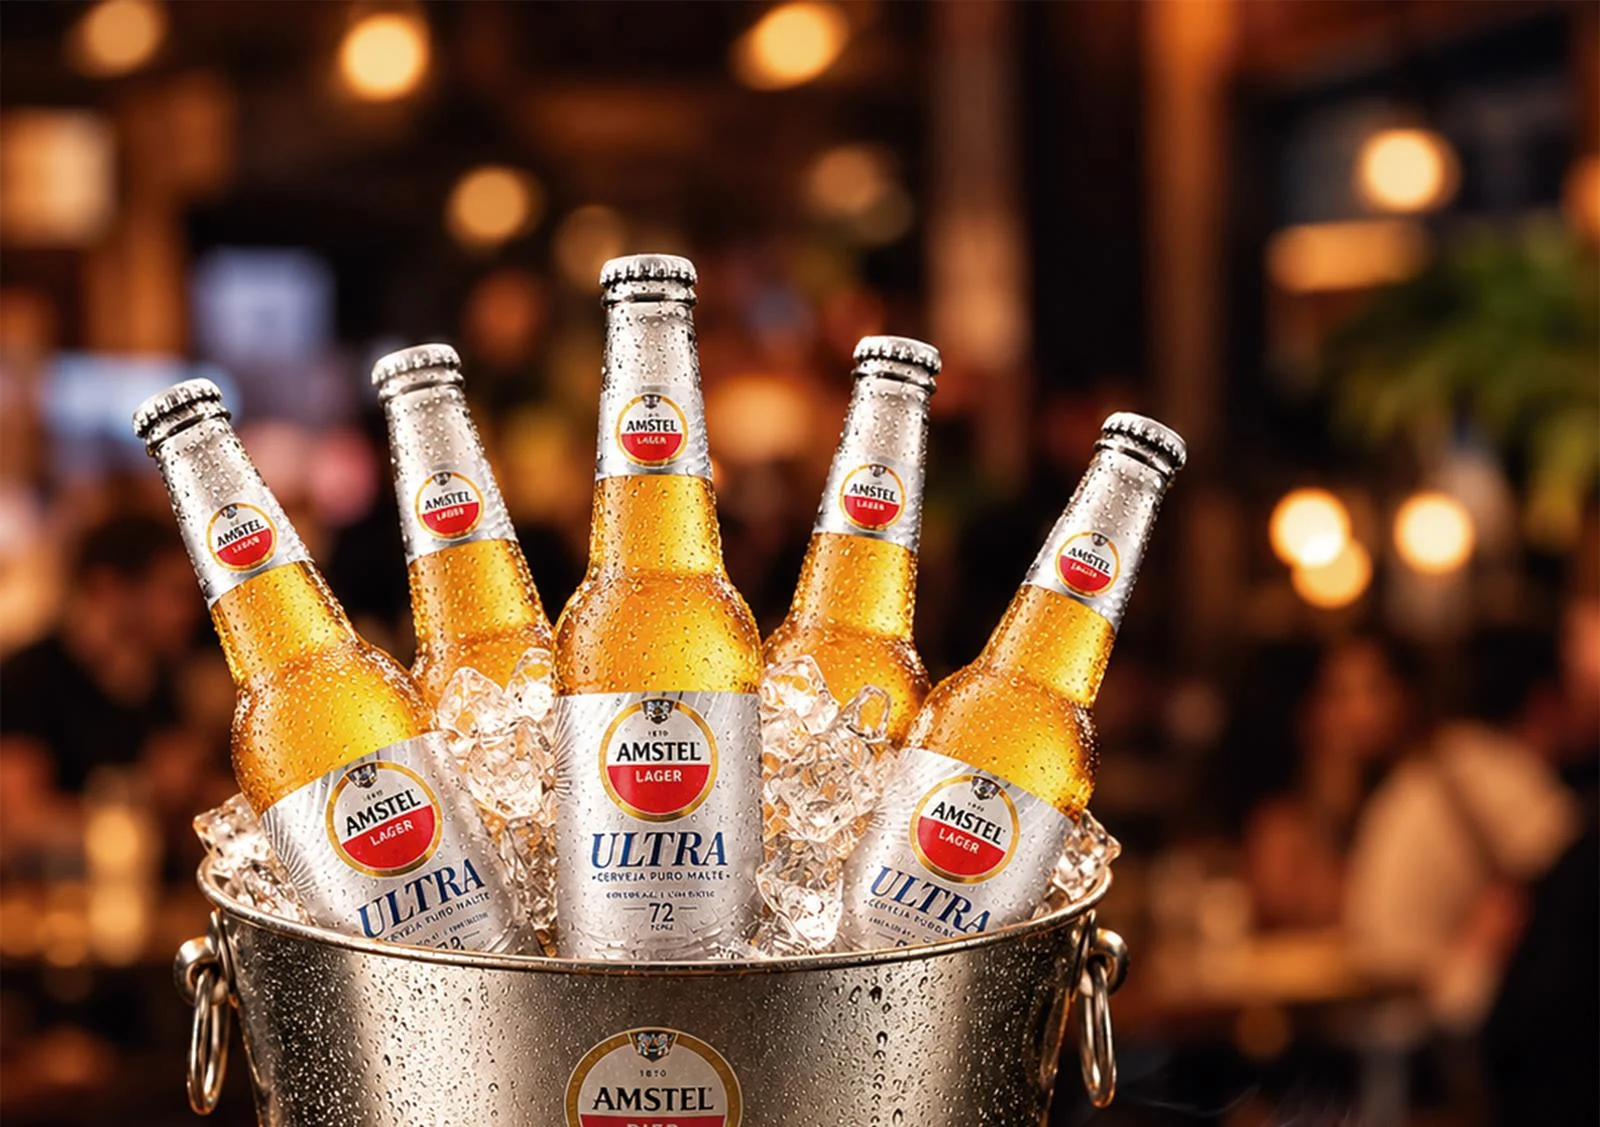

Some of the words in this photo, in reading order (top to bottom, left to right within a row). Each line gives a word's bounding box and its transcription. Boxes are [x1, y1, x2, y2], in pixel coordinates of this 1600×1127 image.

[626, 419, 677, 432] AMSTEL
[425, 491, 472, 510] AMSTEL
[850, 483, 896, 502] AMSTEL
[217, 519, 264, 547] AMSTEL
[1068, 547, 1110, 574] AMSTEL
[616, 742, 701, 762] AMSTEL
[636, 770, 682, 783] LAGER
[346, 789, 421, 837] AMSTEL
[931, 801, 1001, 845] AMSTEL
[370, 819, 414, 846] LAGER
[939, 828, 980, 855] LAGER
[591, 831, 728, 868] ULTRA
[597, 872, 646, 882] CERVEJA
[650, 872, 683, 881] PURO
[688, 871, 724, 880] MALTE
[357, 858, 485, 938] ULTRA
[870, 865, 990, 933] ULTRA
[649, 902, 674, 923] 72
[592, 1087, 714, 1111] AMSTEL
